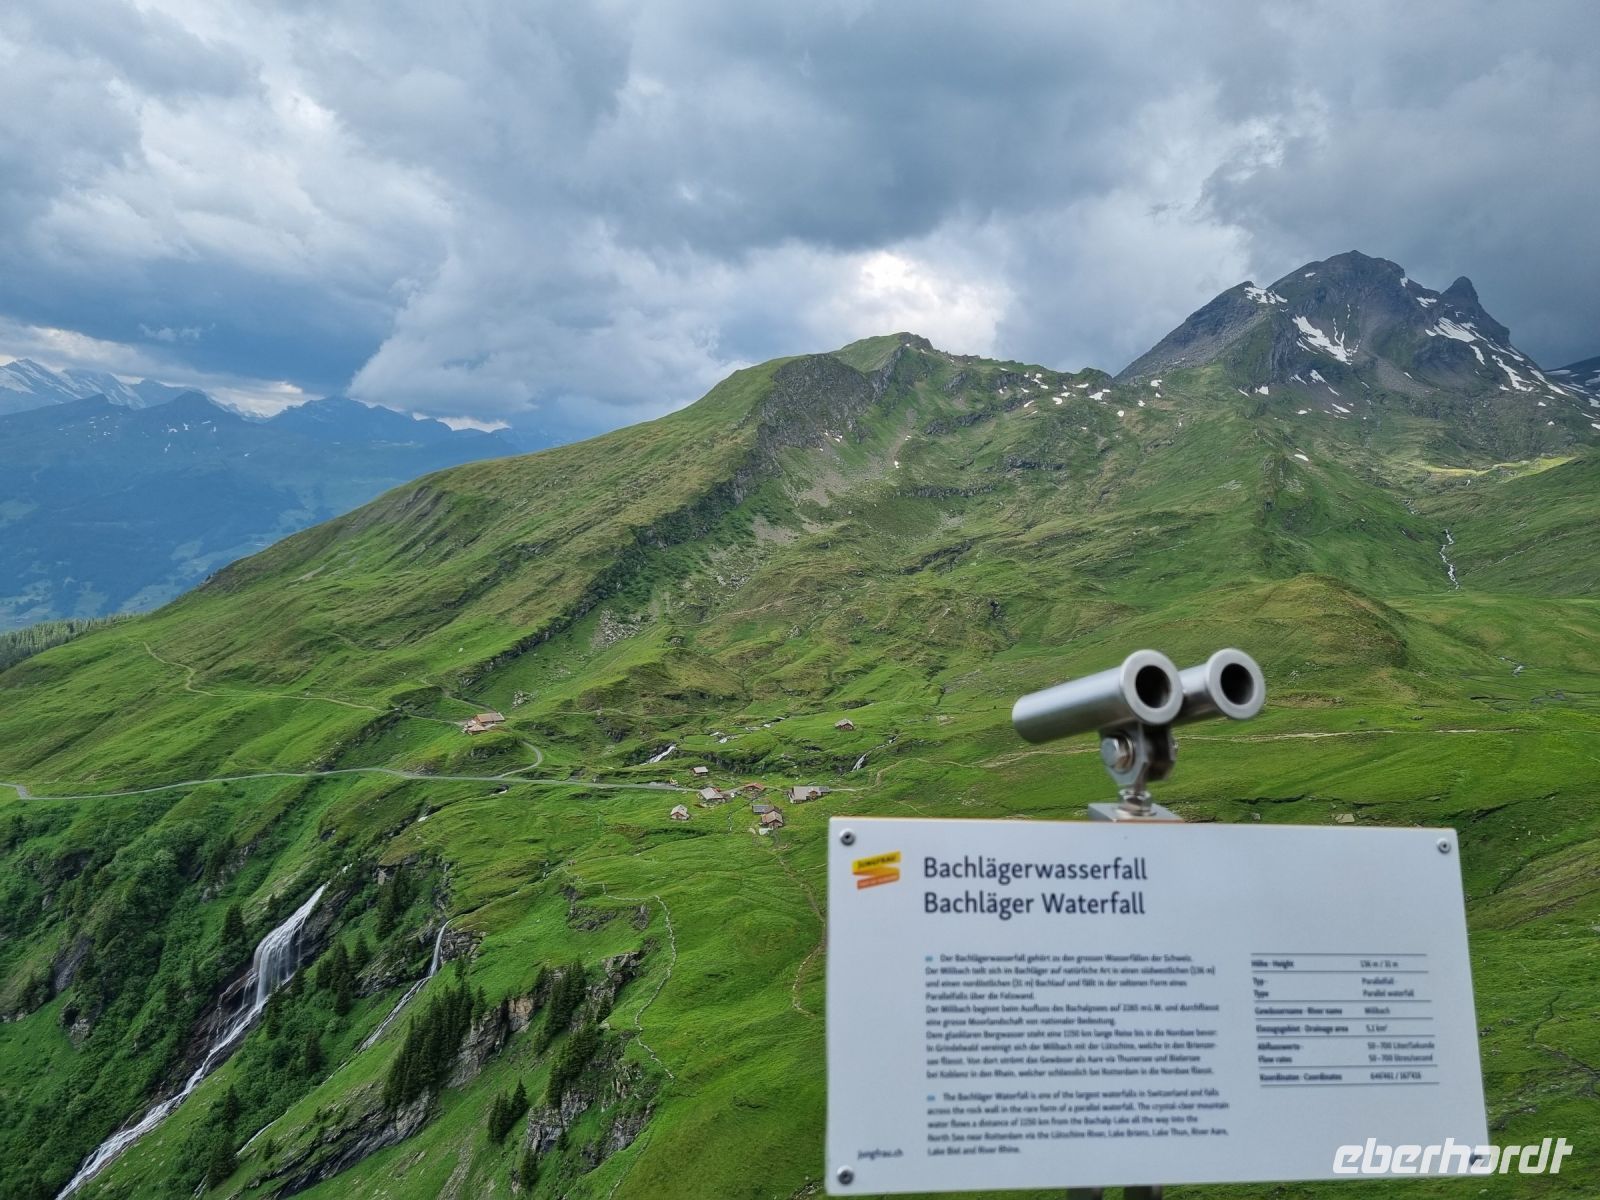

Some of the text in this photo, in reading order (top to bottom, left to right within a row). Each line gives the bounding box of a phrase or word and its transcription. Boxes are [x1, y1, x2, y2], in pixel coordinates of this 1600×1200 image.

[924, 856, 1148, 885] Bachlägerwasserfall
[924, 891, 1145, 920] Bachläger Waterfall
